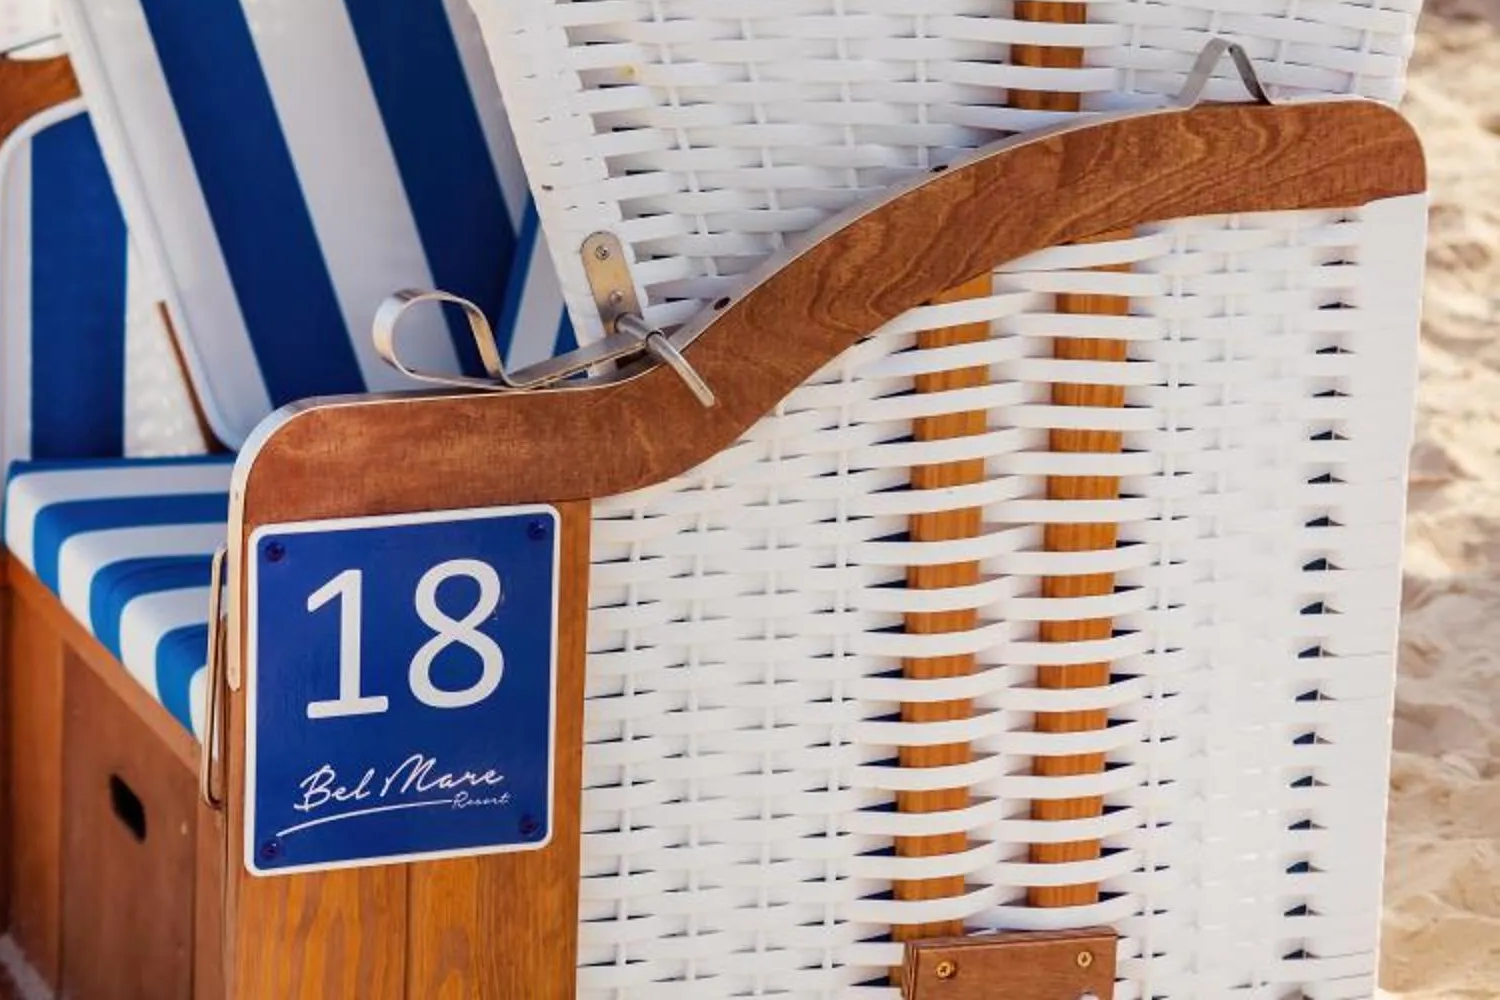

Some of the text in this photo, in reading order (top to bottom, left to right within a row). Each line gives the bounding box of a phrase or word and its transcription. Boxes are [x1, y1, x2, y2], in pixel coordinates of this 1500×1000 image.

[306, 558, 505, 719] 18
[293, 753, 505, 812] Bel Mare
